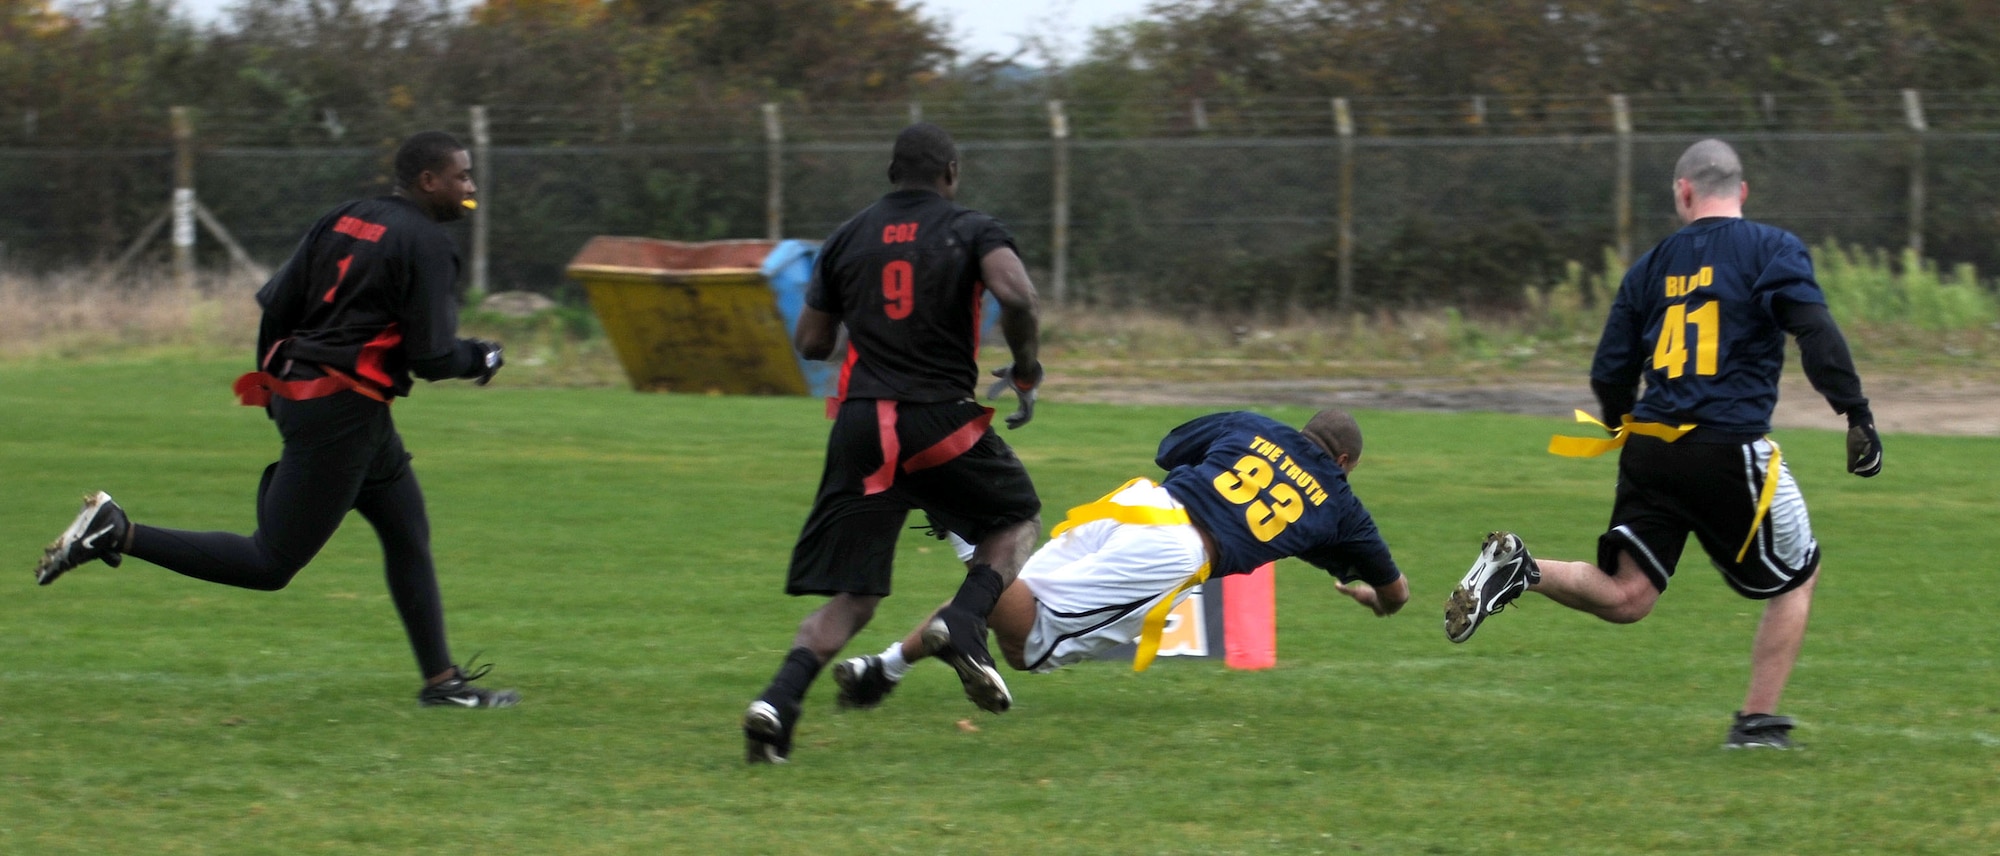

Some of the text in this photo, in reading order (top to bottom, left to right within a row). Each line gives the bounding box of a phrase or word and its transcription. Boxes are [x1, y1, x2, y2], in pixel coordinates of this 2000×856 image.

[883, 222, 918, 244] COZ
[324, 255, 354, 302] 1
[882, 260, 914, 320] 9
[1653, 301, 1720, 380] 41
[1213, 455, 1305, 543] 33
[1249, 435, 1329, 508] THE TRUTH
